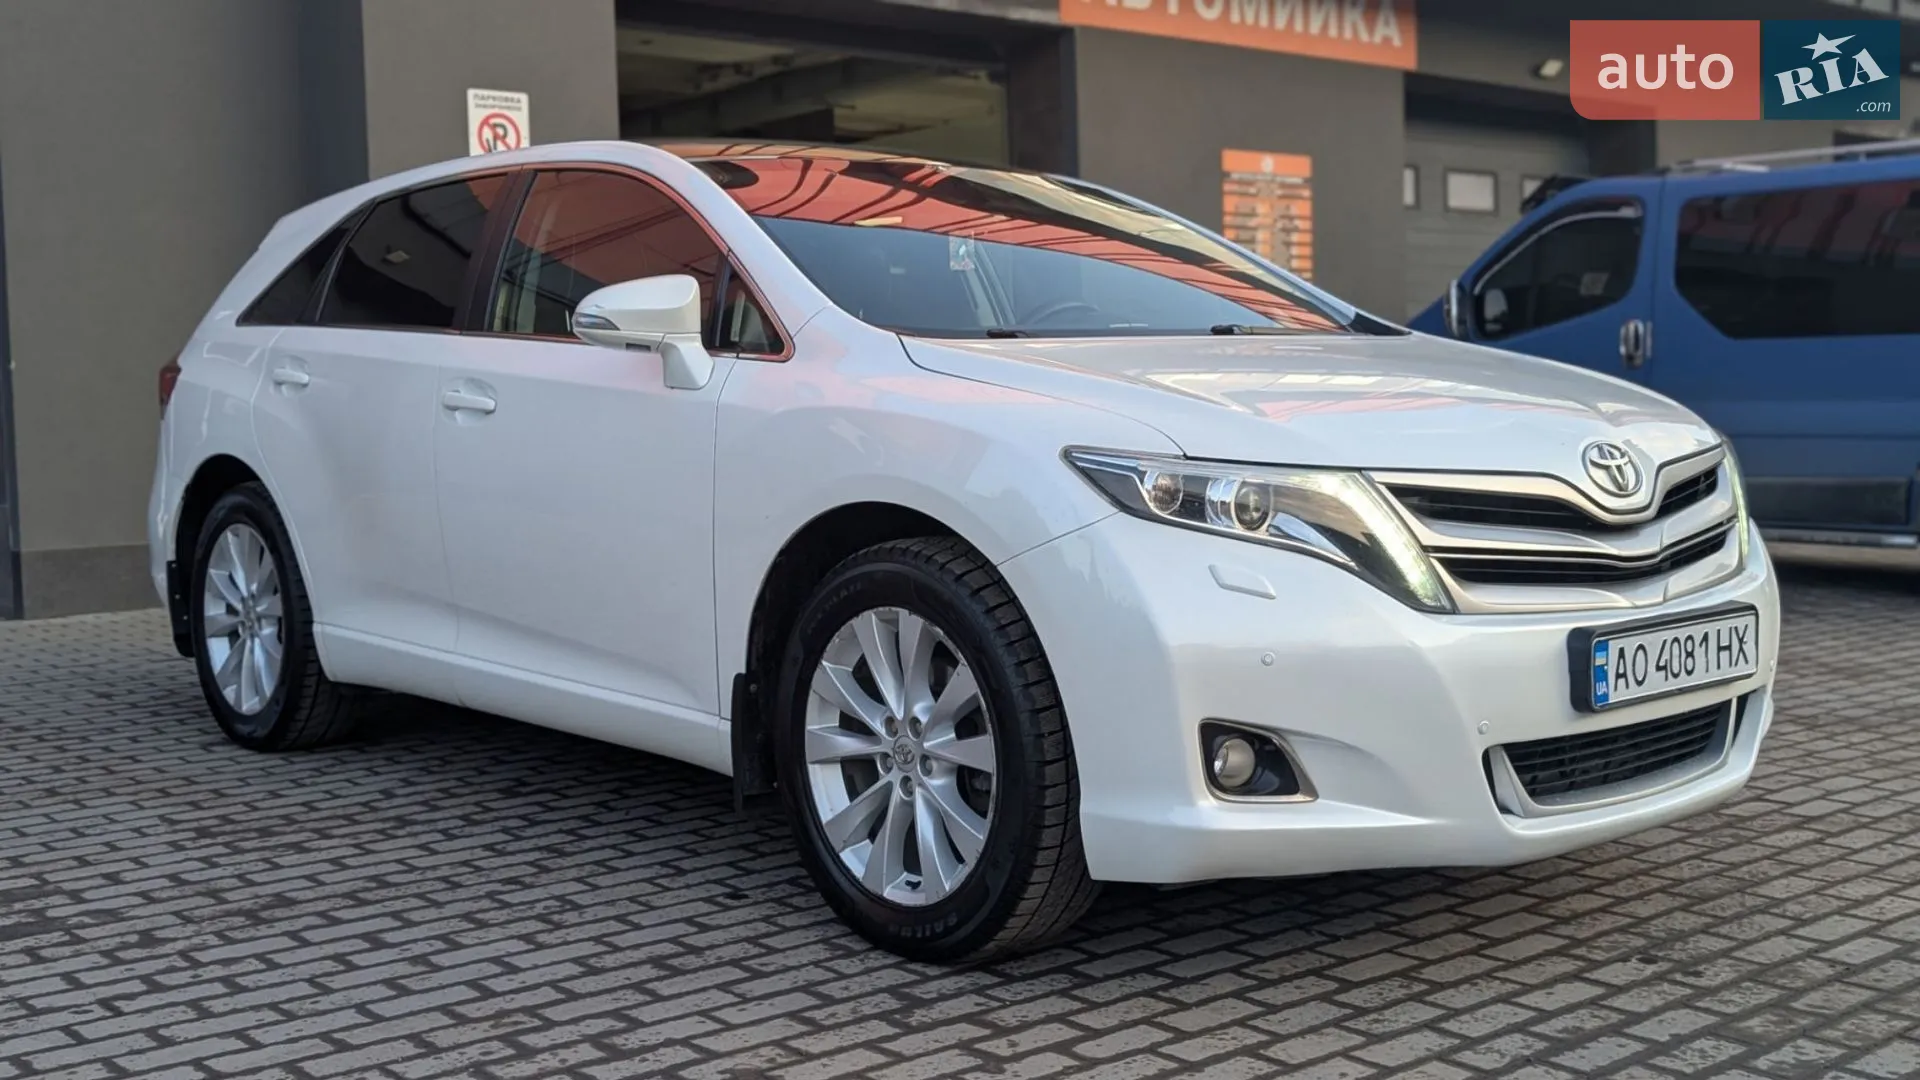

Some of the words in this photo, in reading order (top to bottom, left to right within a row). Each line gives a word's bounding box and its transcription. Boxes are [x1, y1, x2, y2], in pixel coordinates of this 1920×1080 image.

[1613, 642, 1648, 692] AO
[1655, 631, 1710, 682] 4081
[1716, 623, 1750, 671] HX
[1596, 683, 1608, 696] UA
